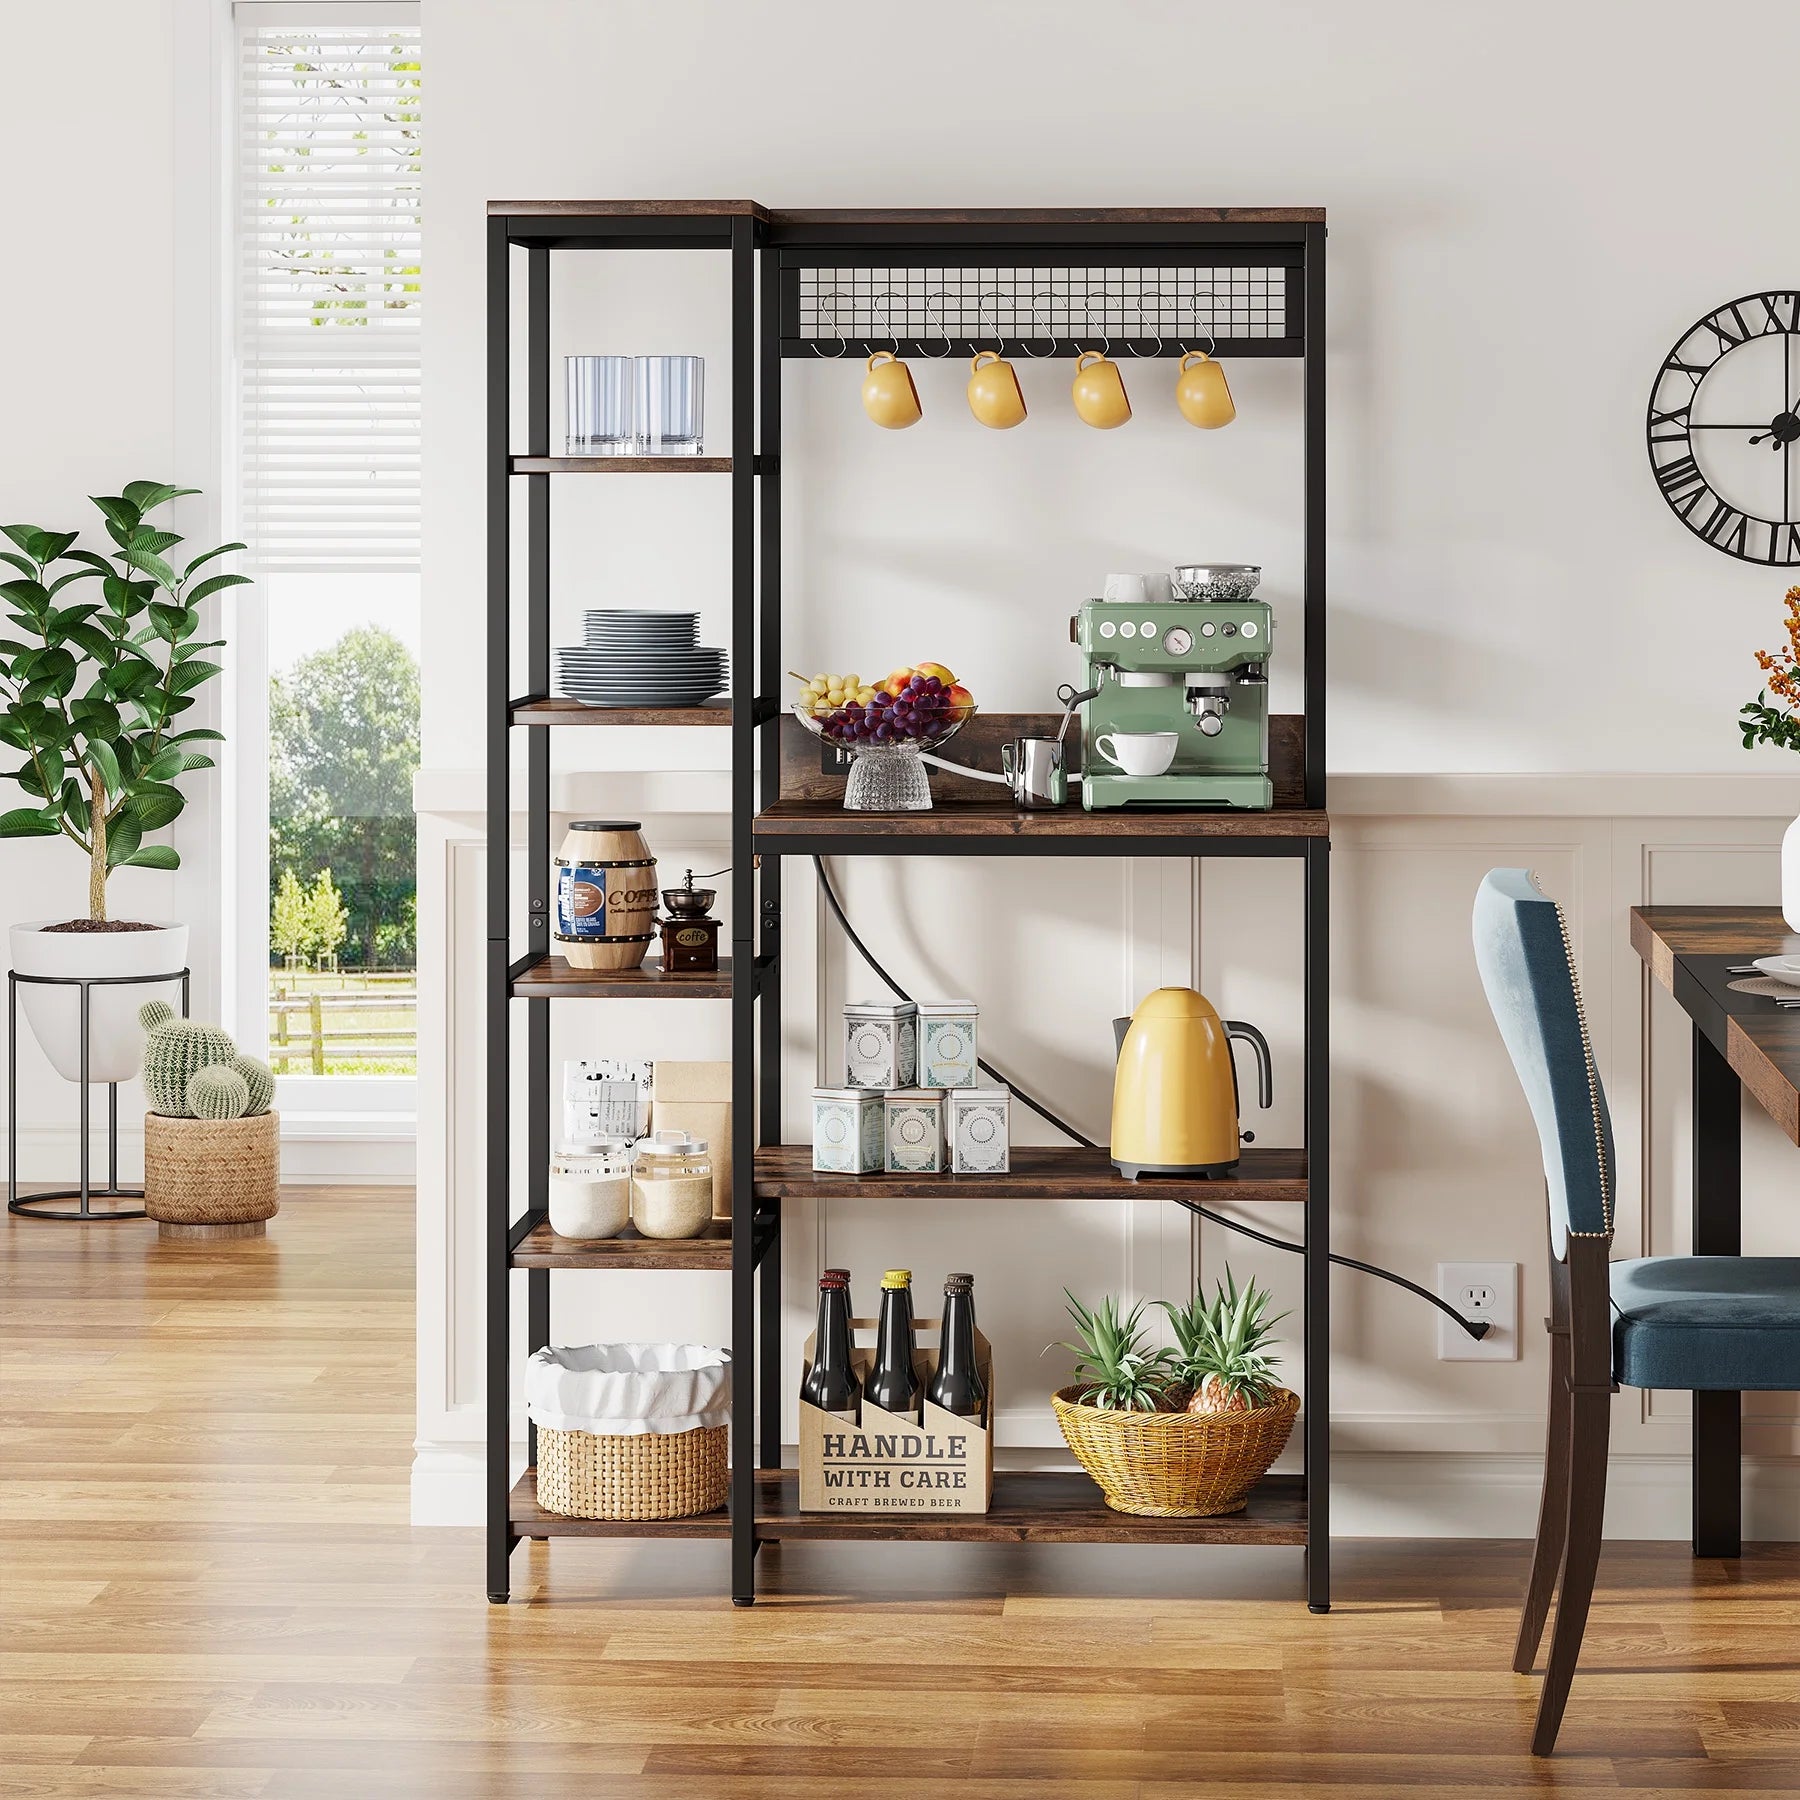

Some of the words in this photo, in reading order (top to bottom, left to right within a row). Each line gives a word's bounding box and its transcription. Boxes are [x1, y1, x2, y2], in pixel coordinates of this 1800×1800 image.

[1759, 293, 1800, 334] XI
[679, 930, 706, 942] coffe
[823, 1434, 967, 1459] HANDLE
[823, 1470, 891, 1488] WITH
[900, 1471, 967, 1489] CARE
[829, 1497, 869, 1506] CRAFT
[874, 1498, 925, 1507] BREWED
[930, 1498, 961, 1507] BEER
